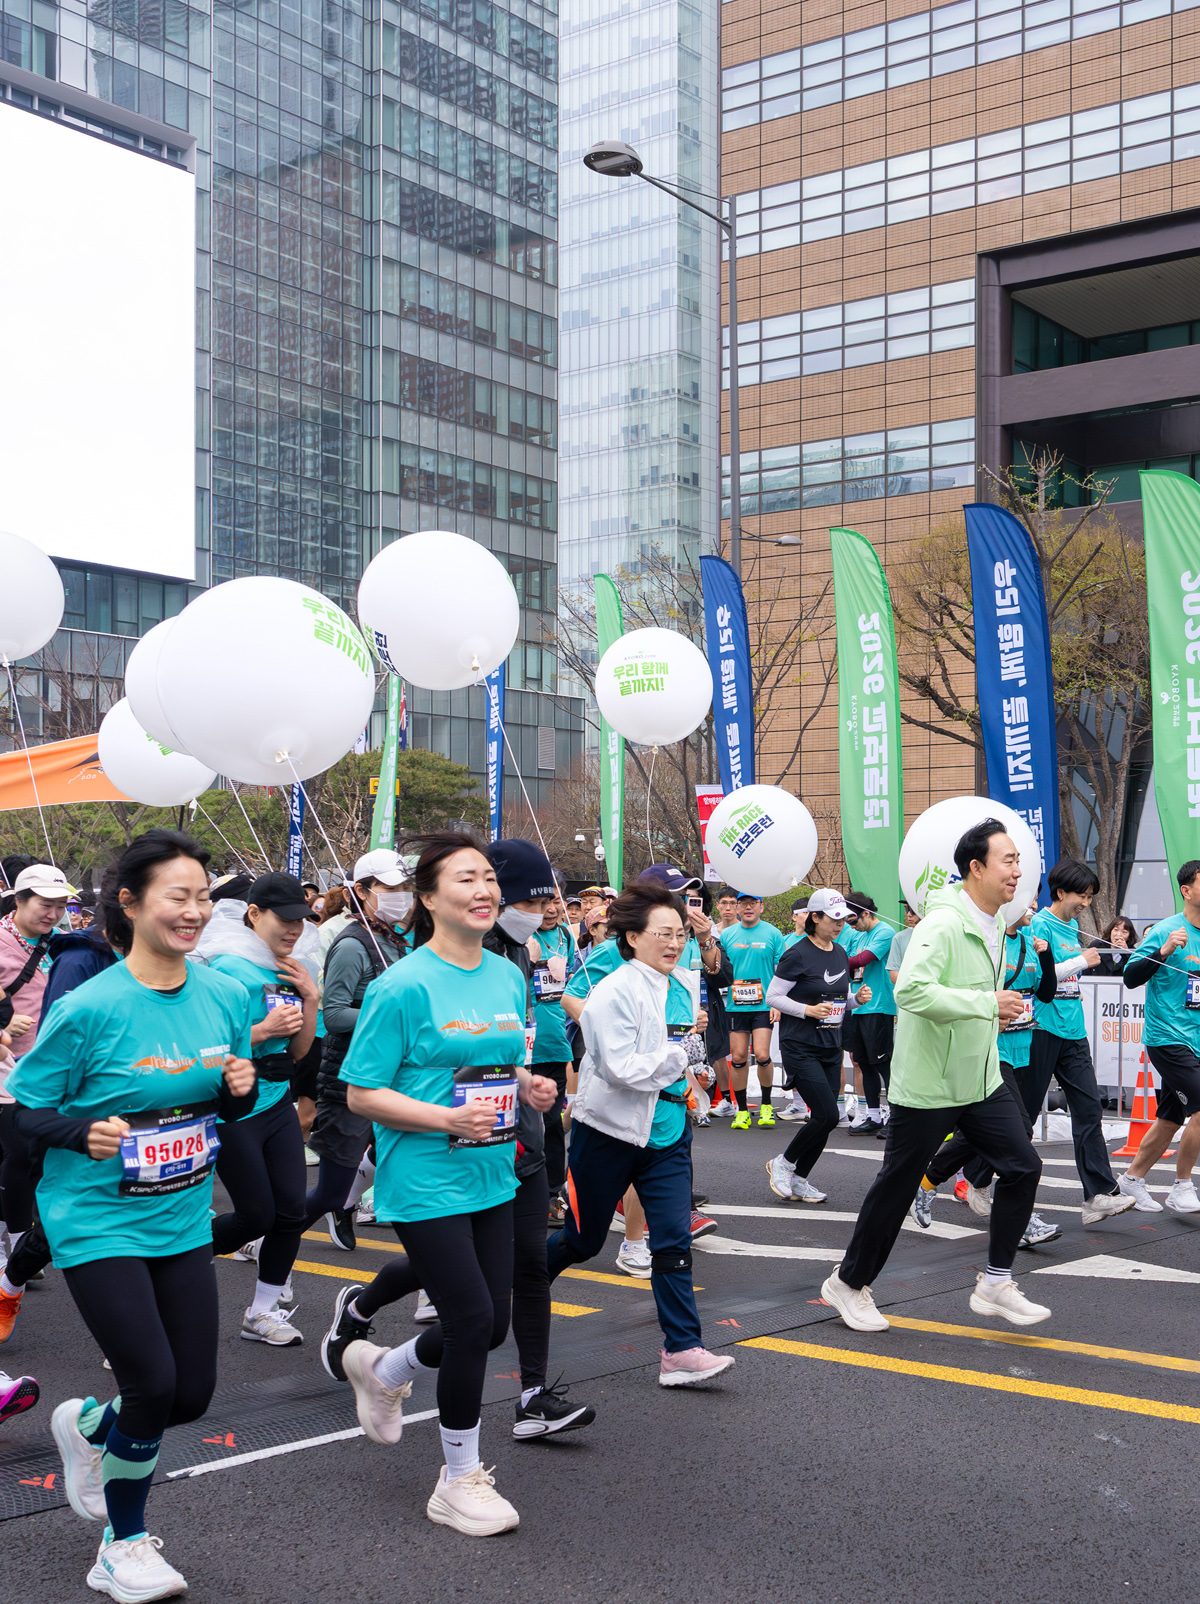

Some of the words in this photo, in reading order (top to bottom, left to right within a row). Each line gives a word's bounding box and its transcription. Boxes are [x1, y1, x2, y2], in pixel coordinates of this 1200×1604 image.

[314, 618, 370, 678] 끝까지!
[613, 663, 639, 680] 우리
[641, 661, 669, 677] 함께
[619, 677, 665, 697] 끝까지!
[721, 826, 741, 848] THE
[736, 804, 765, 831] RACE
[731, 814, 775, 859] 교보로런
[1132, 1003, 1145, 1018] TH
[1102, 1021, 1145, 1043] SEOU
[159, 1115, 180, 1126] KYOBO
[144, 1133, 204, 1166] 95028
[208, 1137, 220, 1148] ALL
[124, 1158, 140, 1168] ALL
